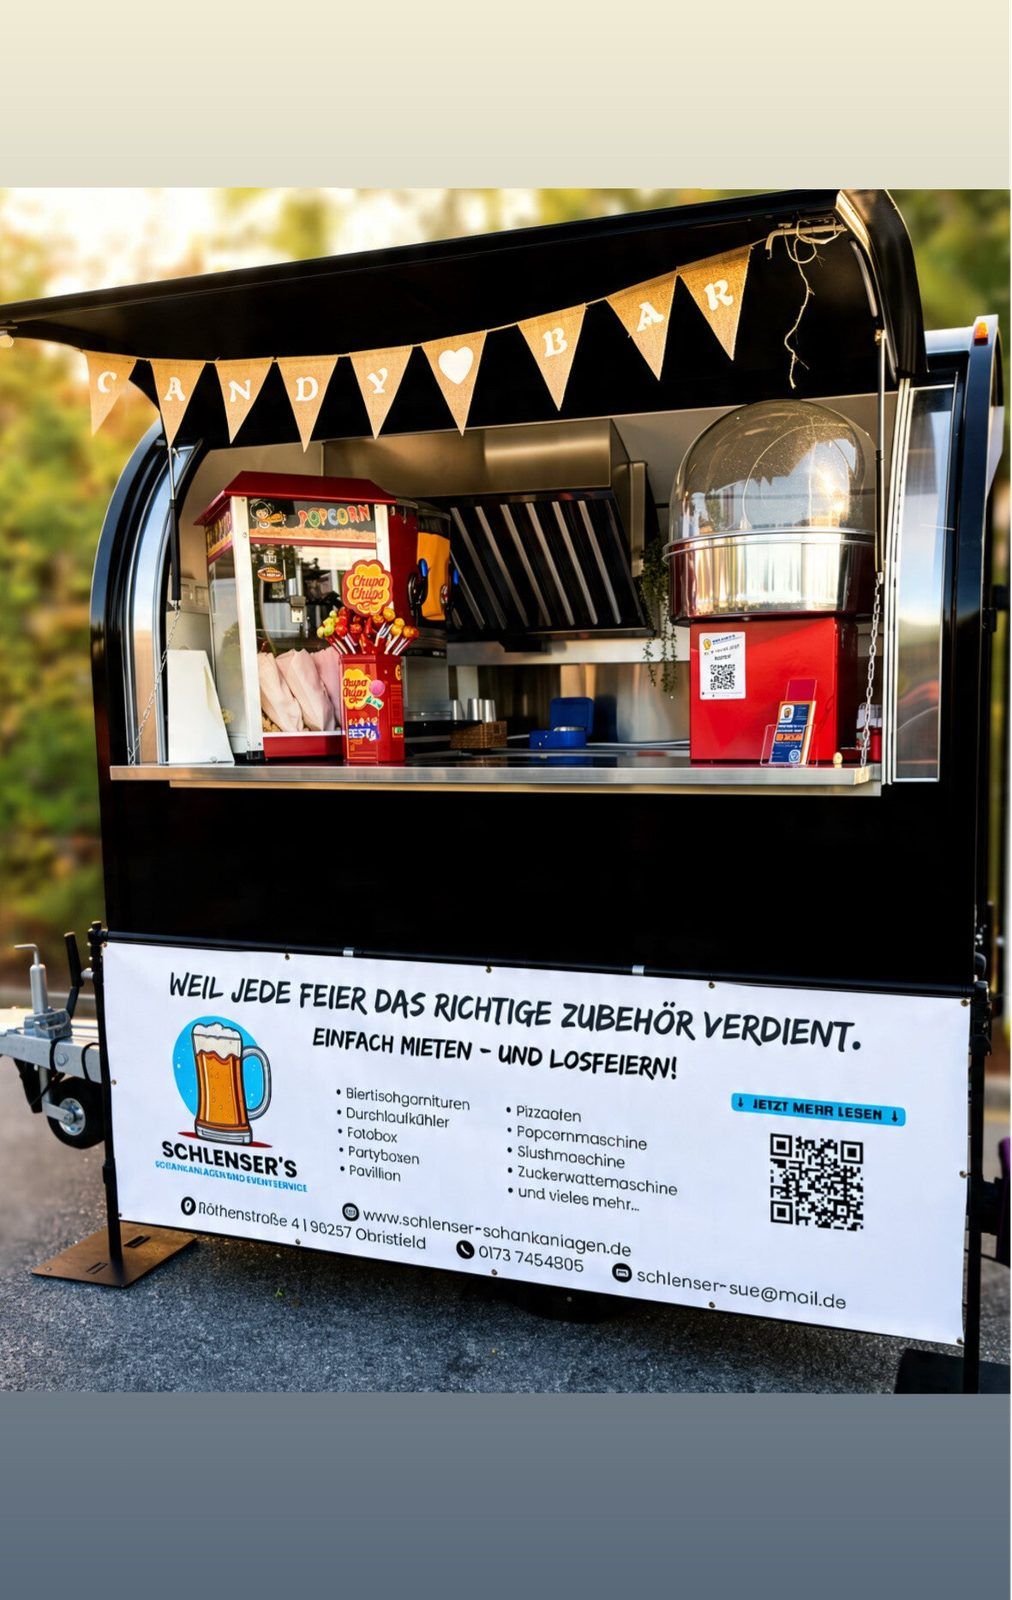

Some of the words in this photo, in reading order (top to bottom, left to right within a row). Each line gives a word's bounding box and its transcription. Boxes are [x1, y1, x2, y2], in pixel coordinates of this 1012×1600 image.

[97, 367, 389, 402] CANDY
[542, 278, 734, 358] BAR
[297, 504, 371, 528] POPCORN
[352, 574, 386, 590] Chupa
[351, 587, 384, 602] Chups
[169, 972, 224, 1000] WEIL
[231, 978, 291, 1004] JEDE
[299, 983, 368, 1015] FEIER
[374, 988, 426, 1019] DAS
[434, 993, 552, 1028] RICHTIGE
[561, 1001, 696, 1041] ZUBEHÖR
[704, 1011, 861, 1053] VERDIENT.
[313, 1027, 394, 1053] EINFACH
[401, 1036, 473, 1060] MIETEN
[498, 1044, 543, 1067] UND
[550, 1049, 677, 1081] LOSFEIERN!
[752, 1098, 789, 1112] JETZT
[838, 1105, 882, 1121] LESEN
[347, 1126, 398, 1143] Fotobox
[516, 1125, 648, 1151] Popcornmaschine
[162, 1140, 298, 1178] SCHLENSER'S
[348, 1145, 420, 1165] Partyboxen
[517, 1145, 626, 1169] Slushmaschine
[349, 1164, 401, 1182] Pavillion
[517, 1165, 678, 1196] Zuckerwattemaschine
[518, 1186, 545, 1200] und
[549, 1189, 589, 1206] vieles
[291, 1217, 300, 1230] 4
[478, 1244, 512, 1263] 0173
[636, 1270, 847, 1310] schlenser-sue@mail.de
